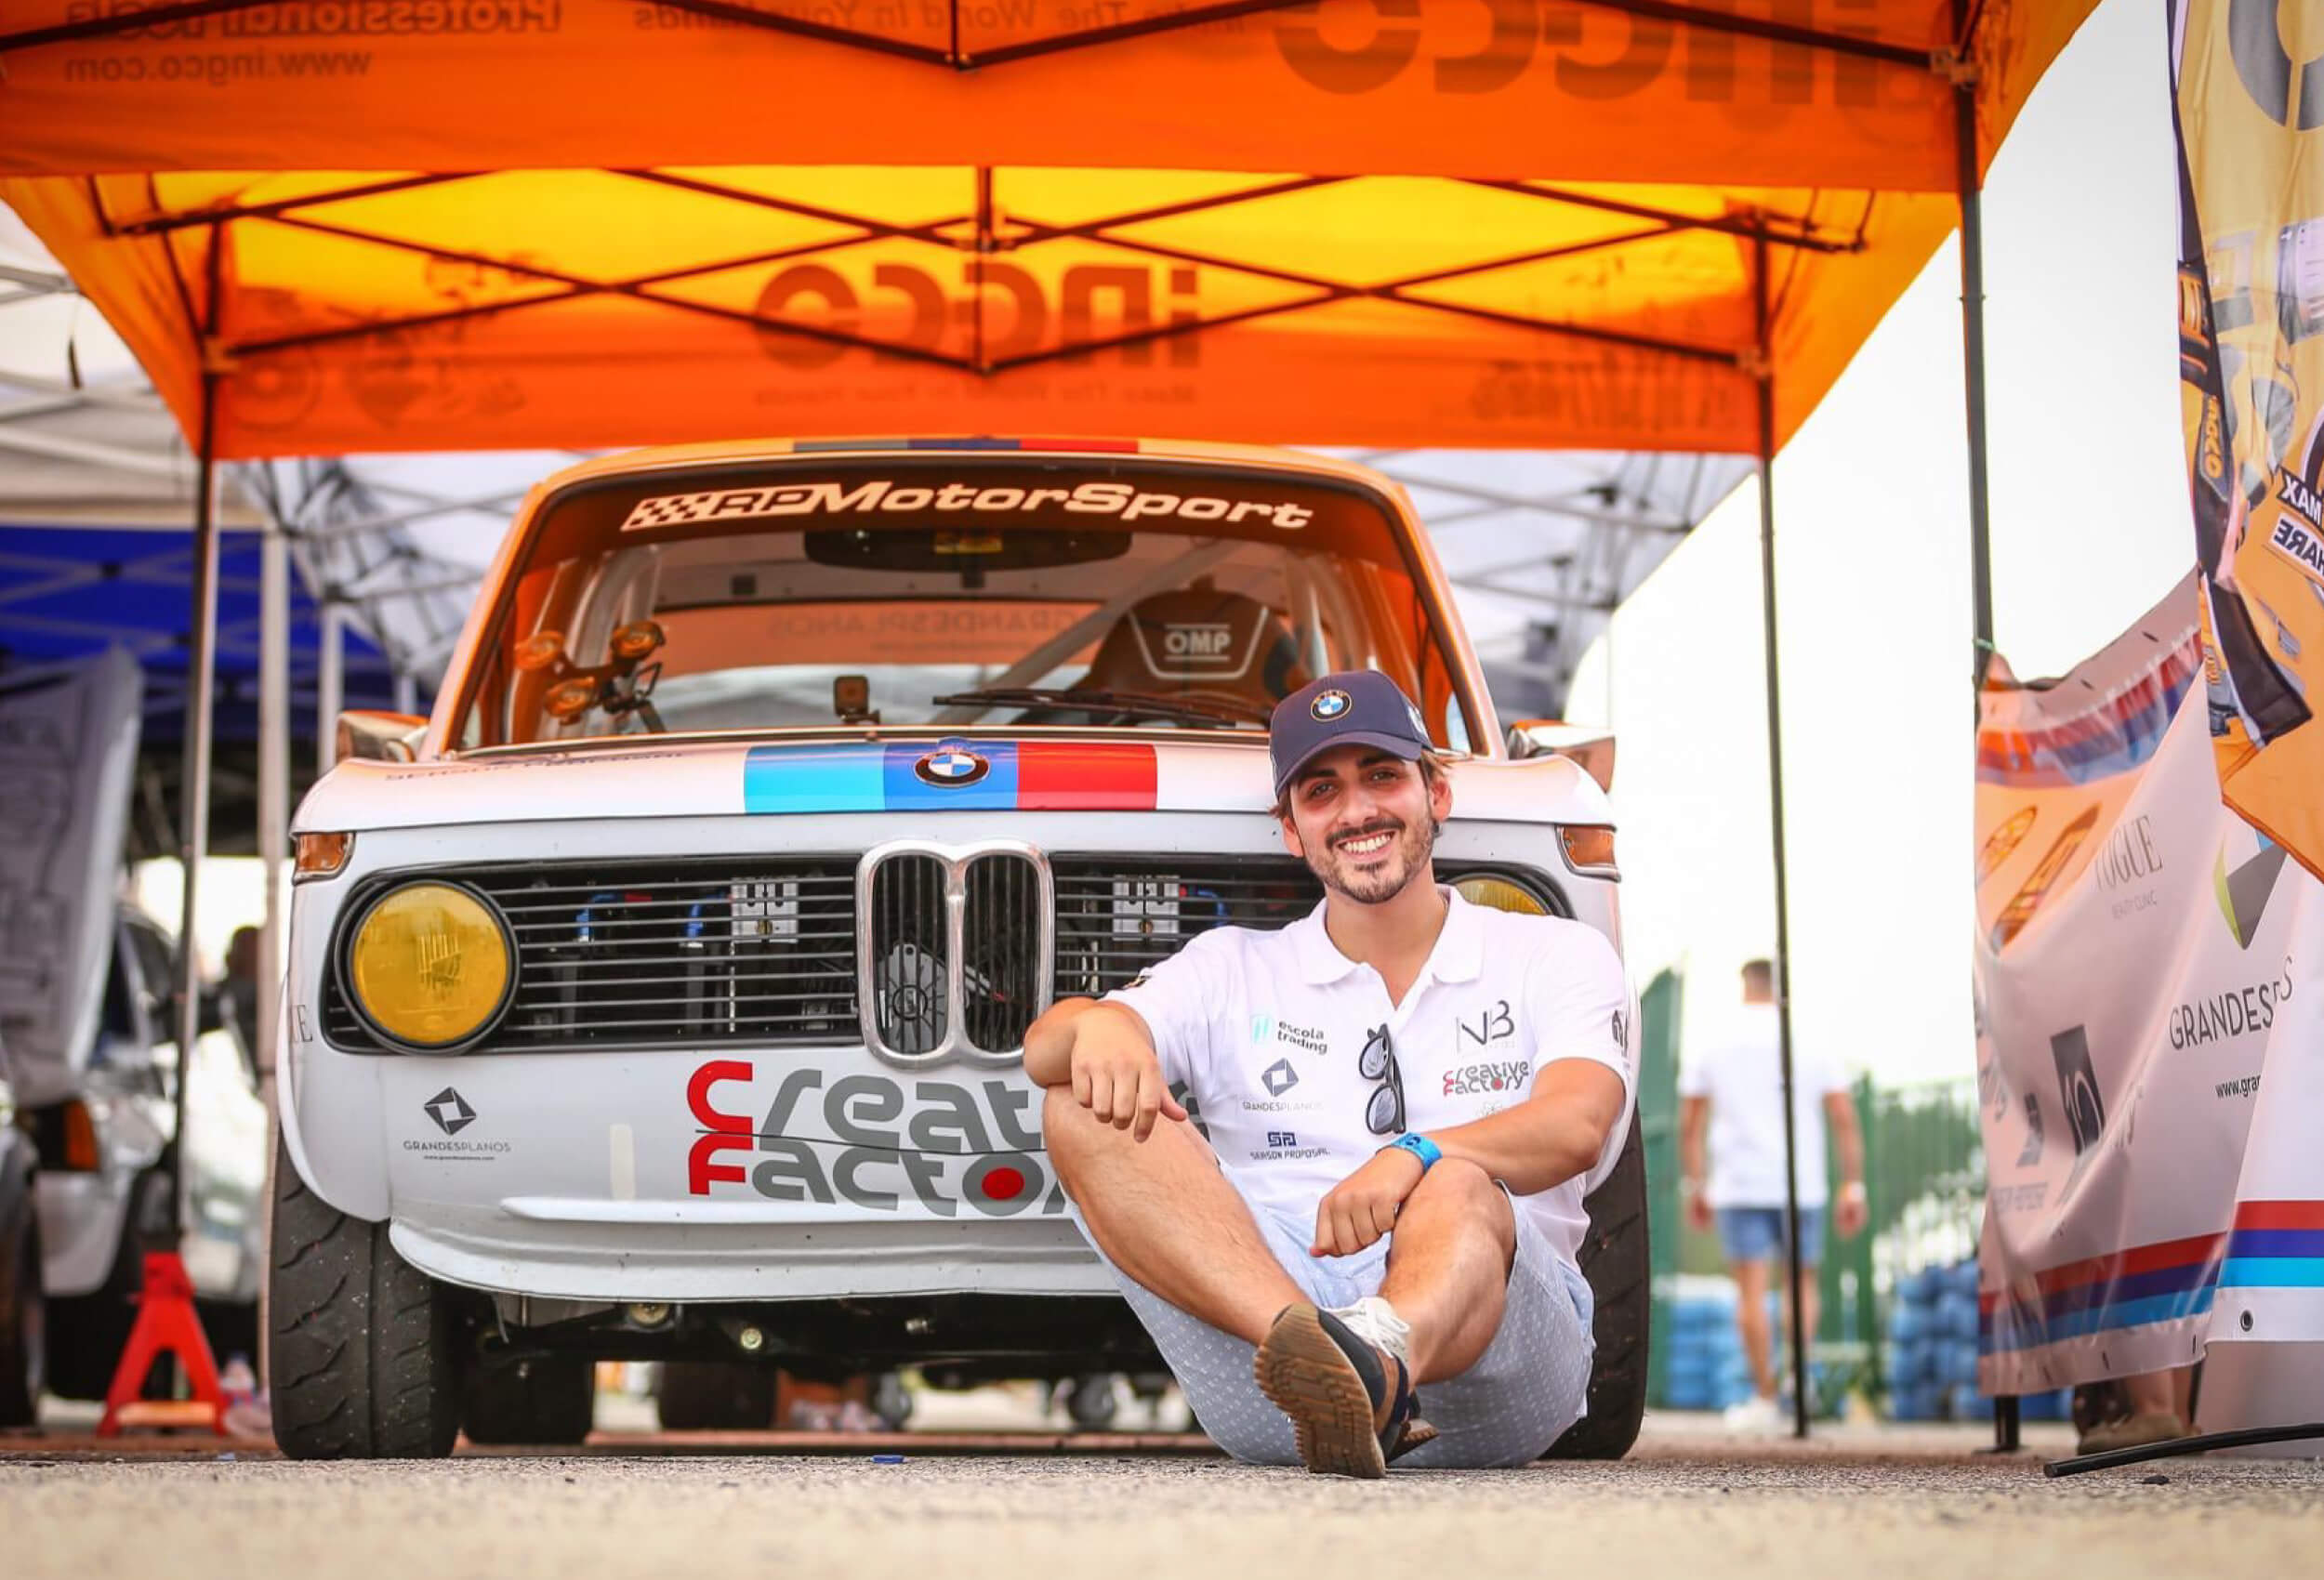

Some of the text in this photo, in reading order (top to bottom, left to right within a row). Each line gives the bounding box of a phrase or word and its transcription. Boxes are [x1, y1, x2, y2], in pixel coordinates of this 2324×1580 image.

[1165, 631, 1231, 653] OMP
[1278, 1020, 1325, 1040] escola
[1277, 1030, 1328, 1056] trading
[687, 1060, 1045, 1152] Creat
[403, 1140, 511, 1152] GRANDESPLANOS
[688, 1132, 1067, 1218] Facto
